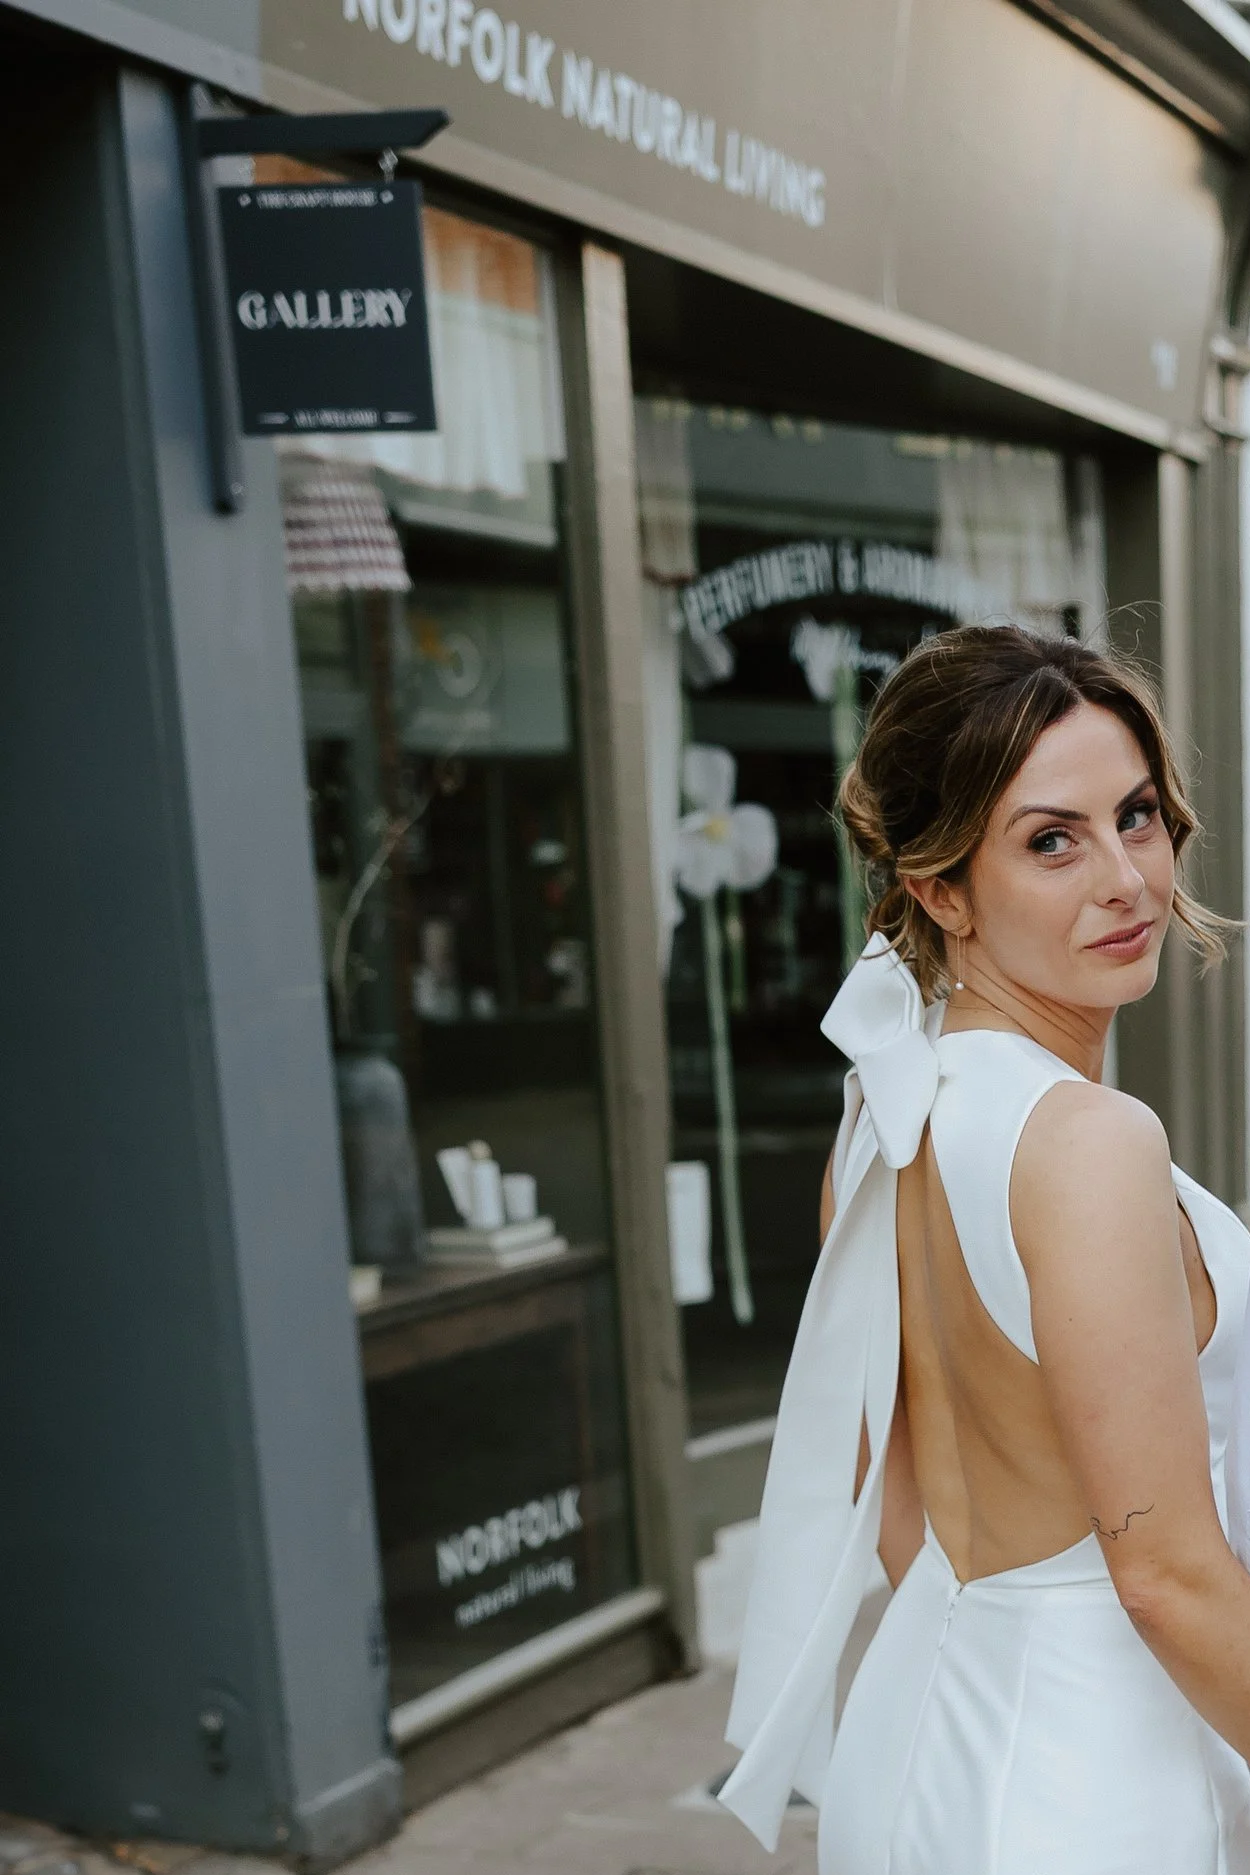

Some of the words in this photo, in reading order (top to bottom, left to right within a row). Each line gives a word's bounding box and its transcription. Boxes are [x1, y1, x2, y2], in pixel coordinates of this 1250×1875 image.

[561, 49, 721, 184] NATURAL
[724, 124, 827, 229] LIVING
[238, 288, 412, 331] GALLERY
[681, 542, 833, 637] PERFUMERY
[838, 539, 861, 595] &
[436, 1485, 583, 1588] NORFOLK
[455, 1571, 524, 1627] natural
[524, 1556, 576, 1592] living
